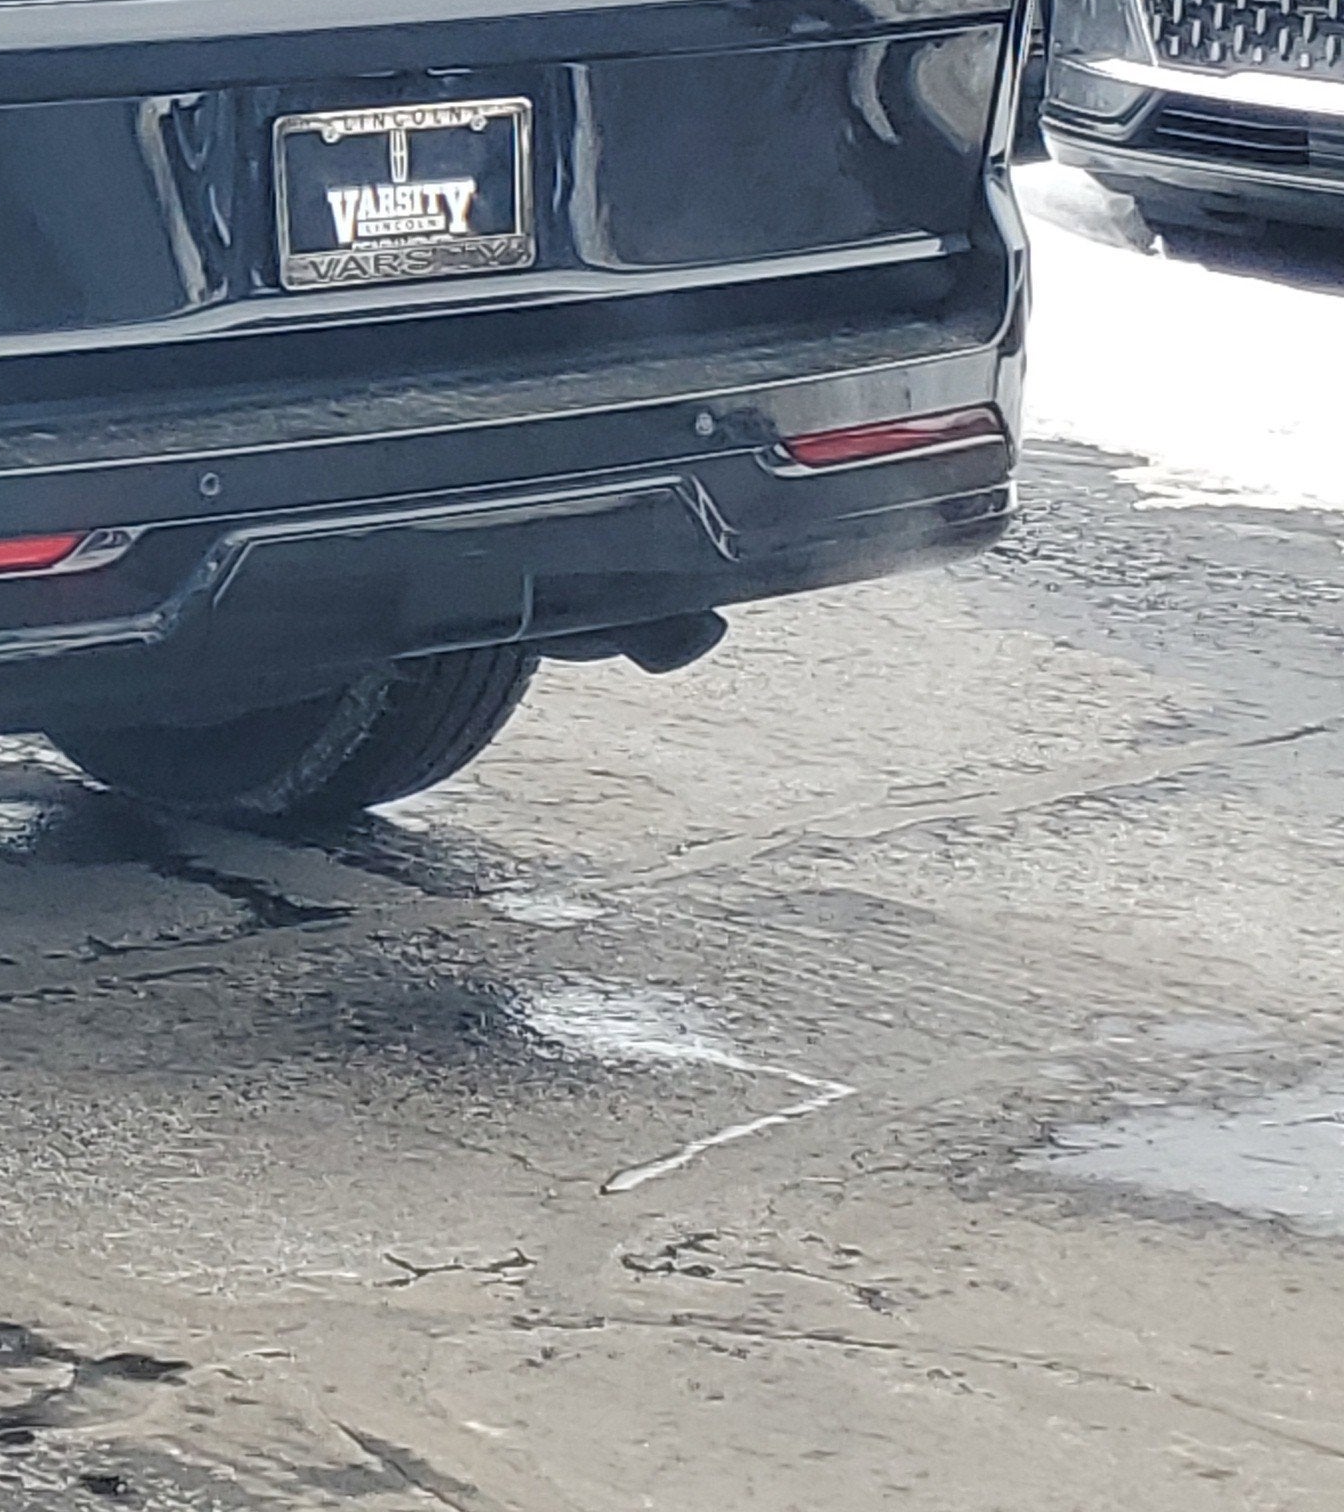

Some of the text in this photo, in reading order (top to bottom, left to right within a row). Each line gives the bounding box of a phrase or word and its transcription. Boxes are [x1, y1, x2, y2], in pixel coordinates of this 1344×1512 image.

[343, 108, 463, 131] LINCOLN
[326, 179, 476, 245] VARSITY
[365, 219, 438, 233] LINCOLN
[310, 241, 507, 281] VARSY
